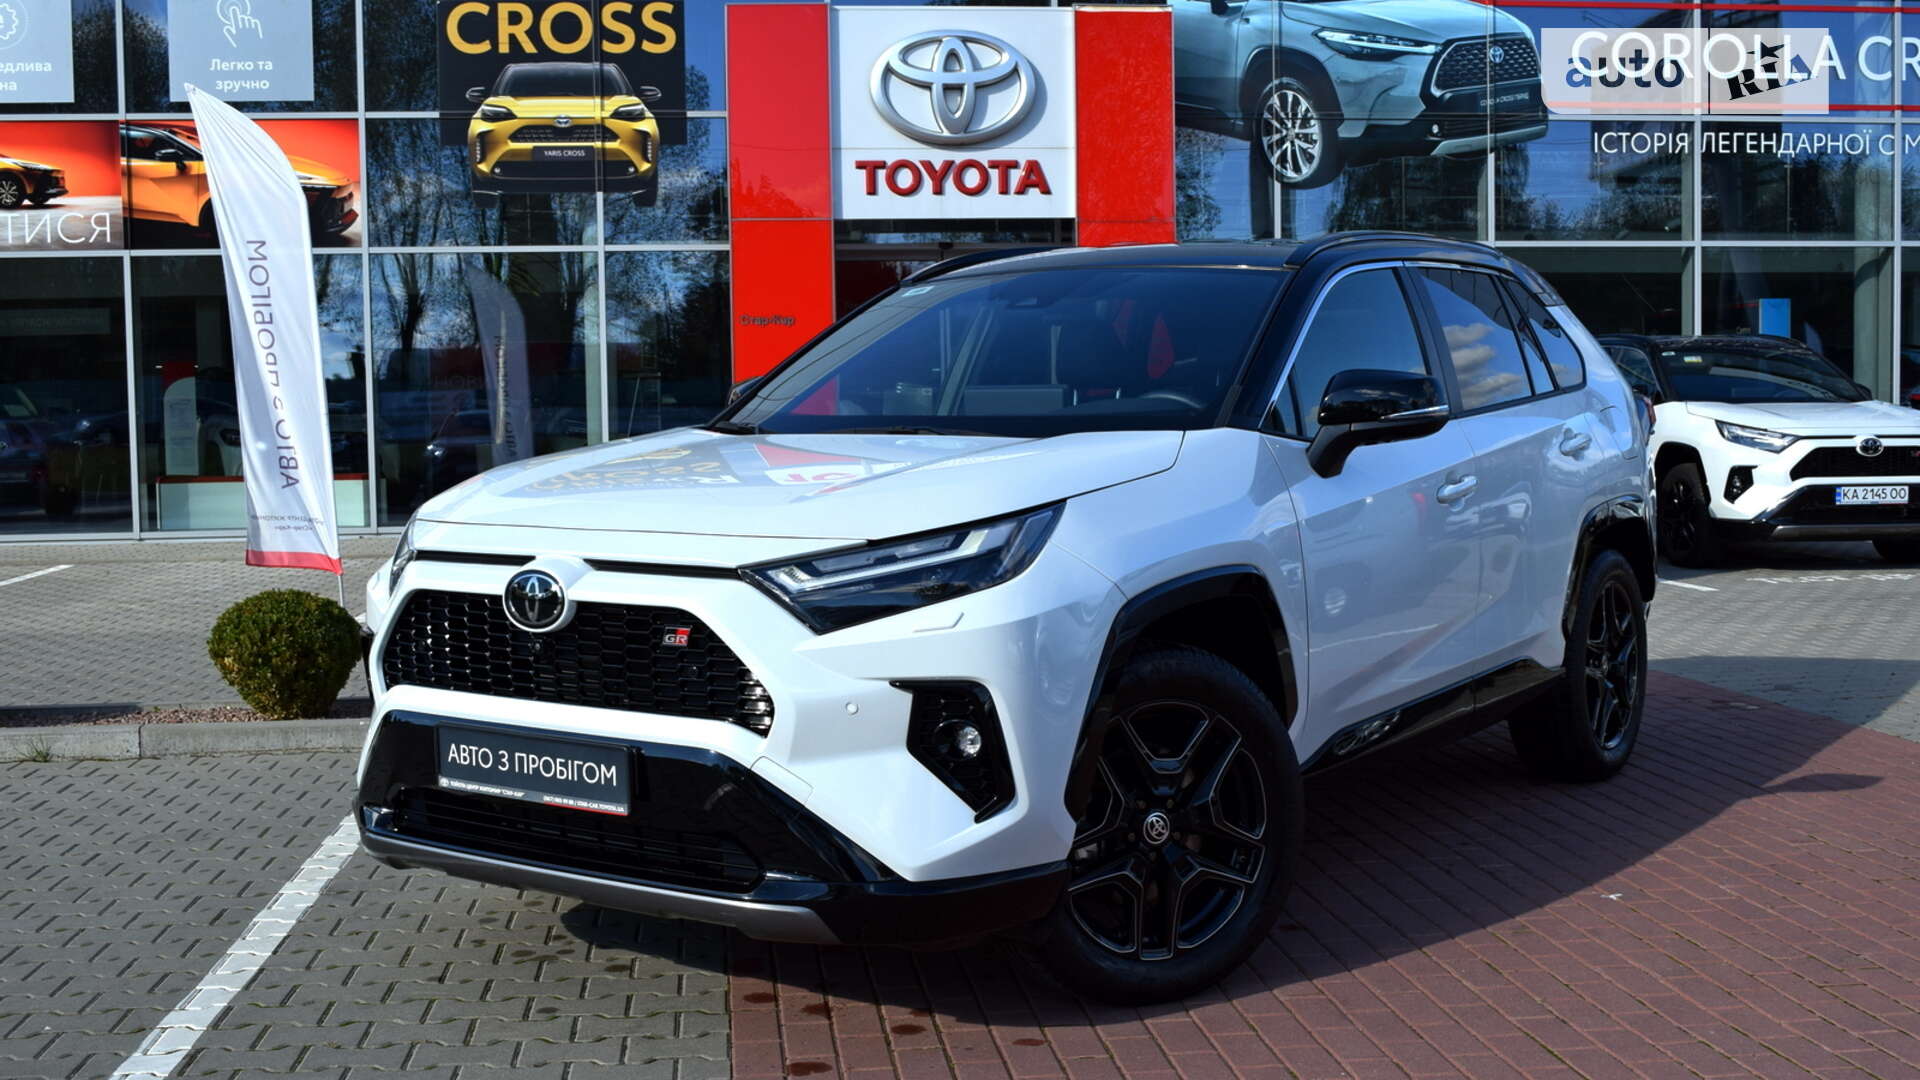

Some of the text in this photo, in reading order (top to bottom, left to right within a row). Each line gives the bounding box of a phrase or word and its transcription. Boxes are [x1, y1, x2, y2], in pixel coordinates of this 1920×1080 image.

[446, 1, 677, 55] CROSS
[209, 58, 273, 71] Легко та
[1571, 31, 1847, 80] COROLLA
[215, 79, 270, 93] зручно
[1594, 131, 1689, 155] ІСТОРІЯ
[1700, 129, 1870, 158] ЛЕГЕНДАРНОЇ
[855, 158, 1053, 198] TOYOTA
[0, 212, 111, 244] ТИСЯ
[1842, 488, 1860, 500] KA
[1861, 487, 1888, 500] 2145
[665, 633, 689, 646] GR
[447, 743, 618, 788] АВТО З ПРОБІГОМ
